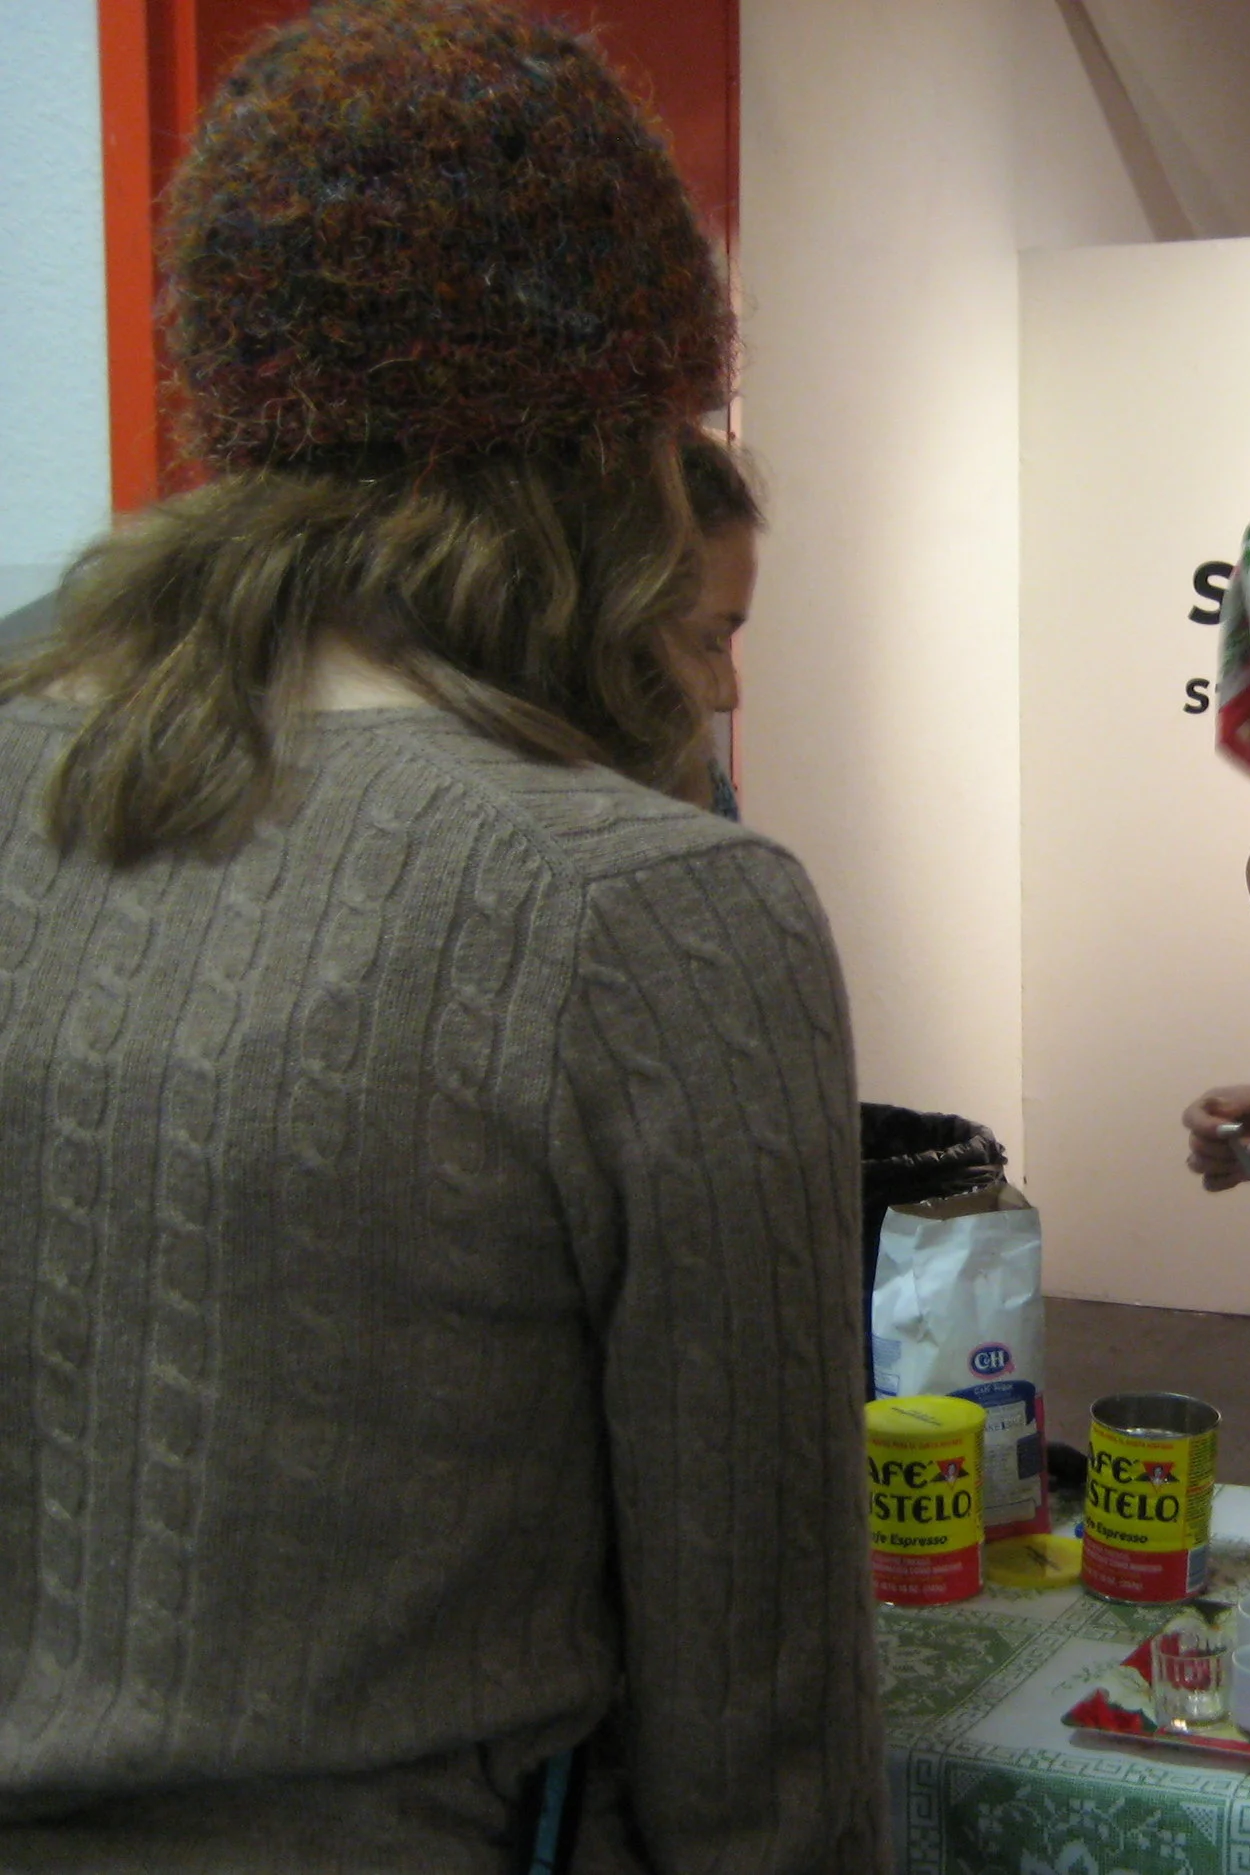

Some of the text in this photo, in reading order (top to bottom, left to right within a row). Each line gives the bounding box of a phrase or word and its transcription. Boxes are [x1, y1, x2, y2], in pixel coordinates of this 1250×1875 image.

[869, 1490, 971, 1523] STELO
[1088, 1479, 1179, 1523] STELO
[891, 1533, 948, 1548] Espresso
[1097, 1521, 1148, 1544] Espresso
